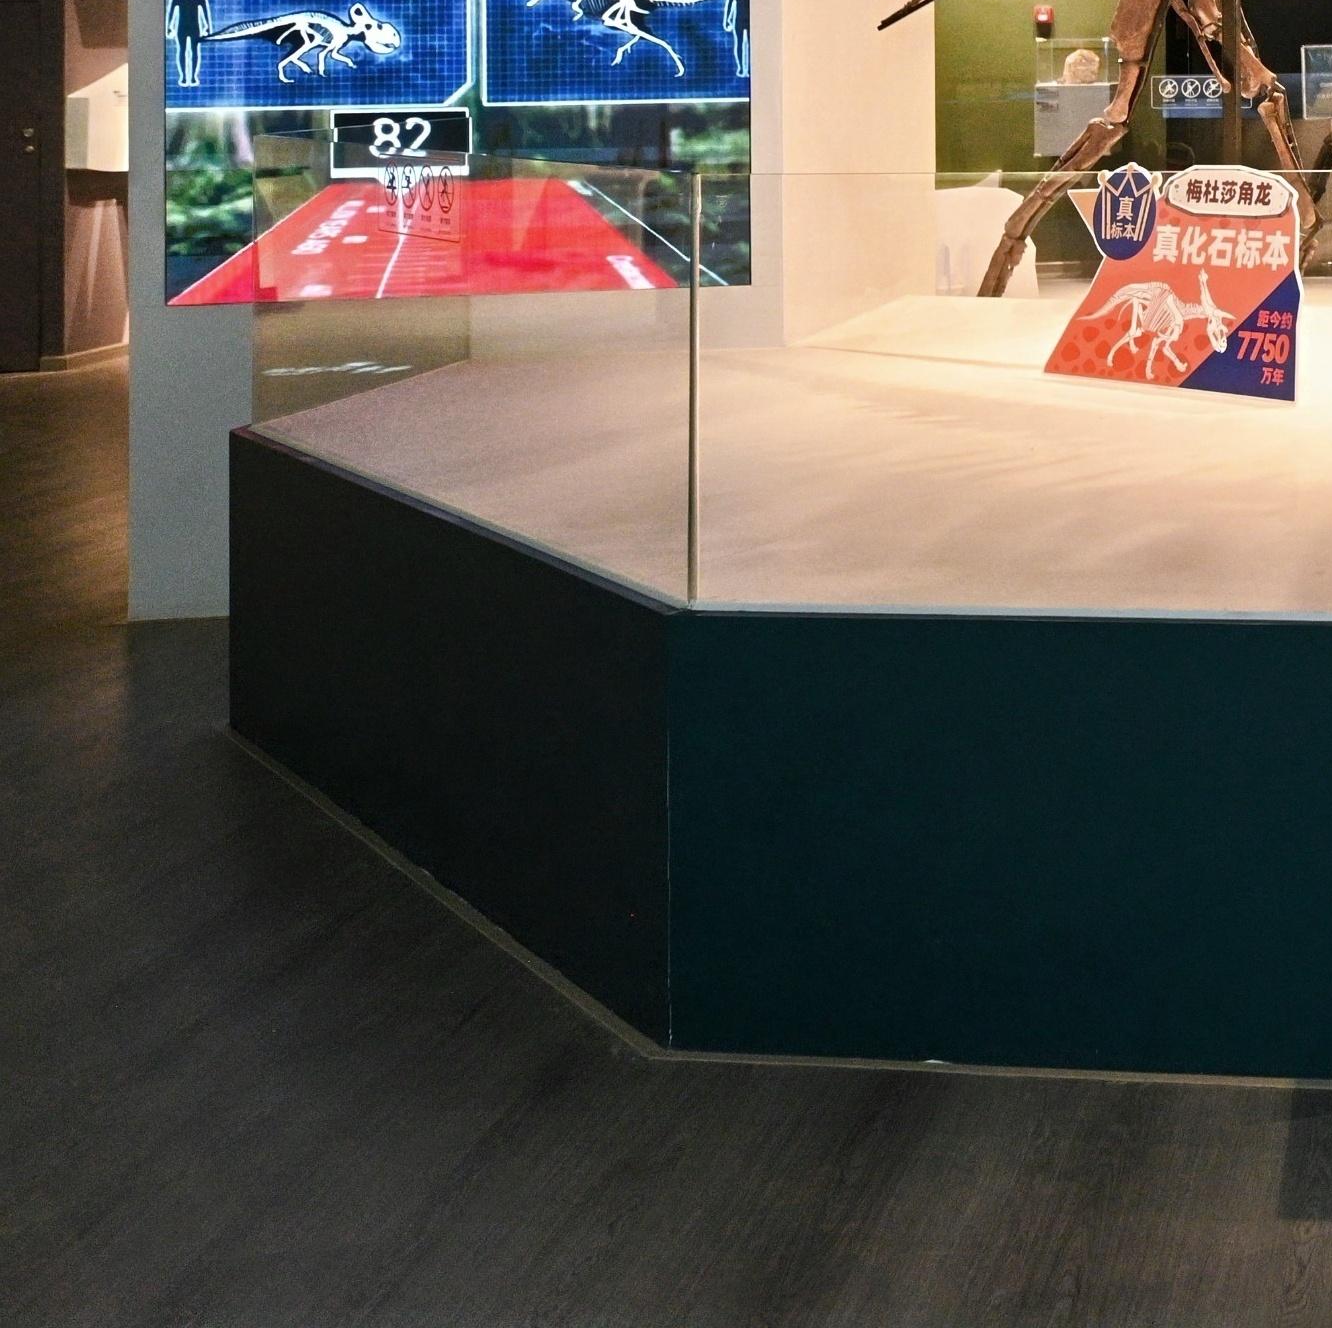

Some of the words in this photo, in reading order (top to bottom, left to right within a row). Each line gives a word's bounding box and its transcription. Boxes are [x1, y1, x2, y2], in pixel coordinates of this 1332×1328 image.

[369, 117, 432, 158] 82
[1185, 179, 1273, 207] 梅杜莎角龙
[1116, 196, 1134, 221] 真
[1110, 222, 1136, 240] 标本
[1152, 224, 1292, 272] 真化石标本
[1256, 310, 1293, 330] 距今约
[1236, 331, 1291, 364] 7750
[1259, 367, 1285, 386] 万年
